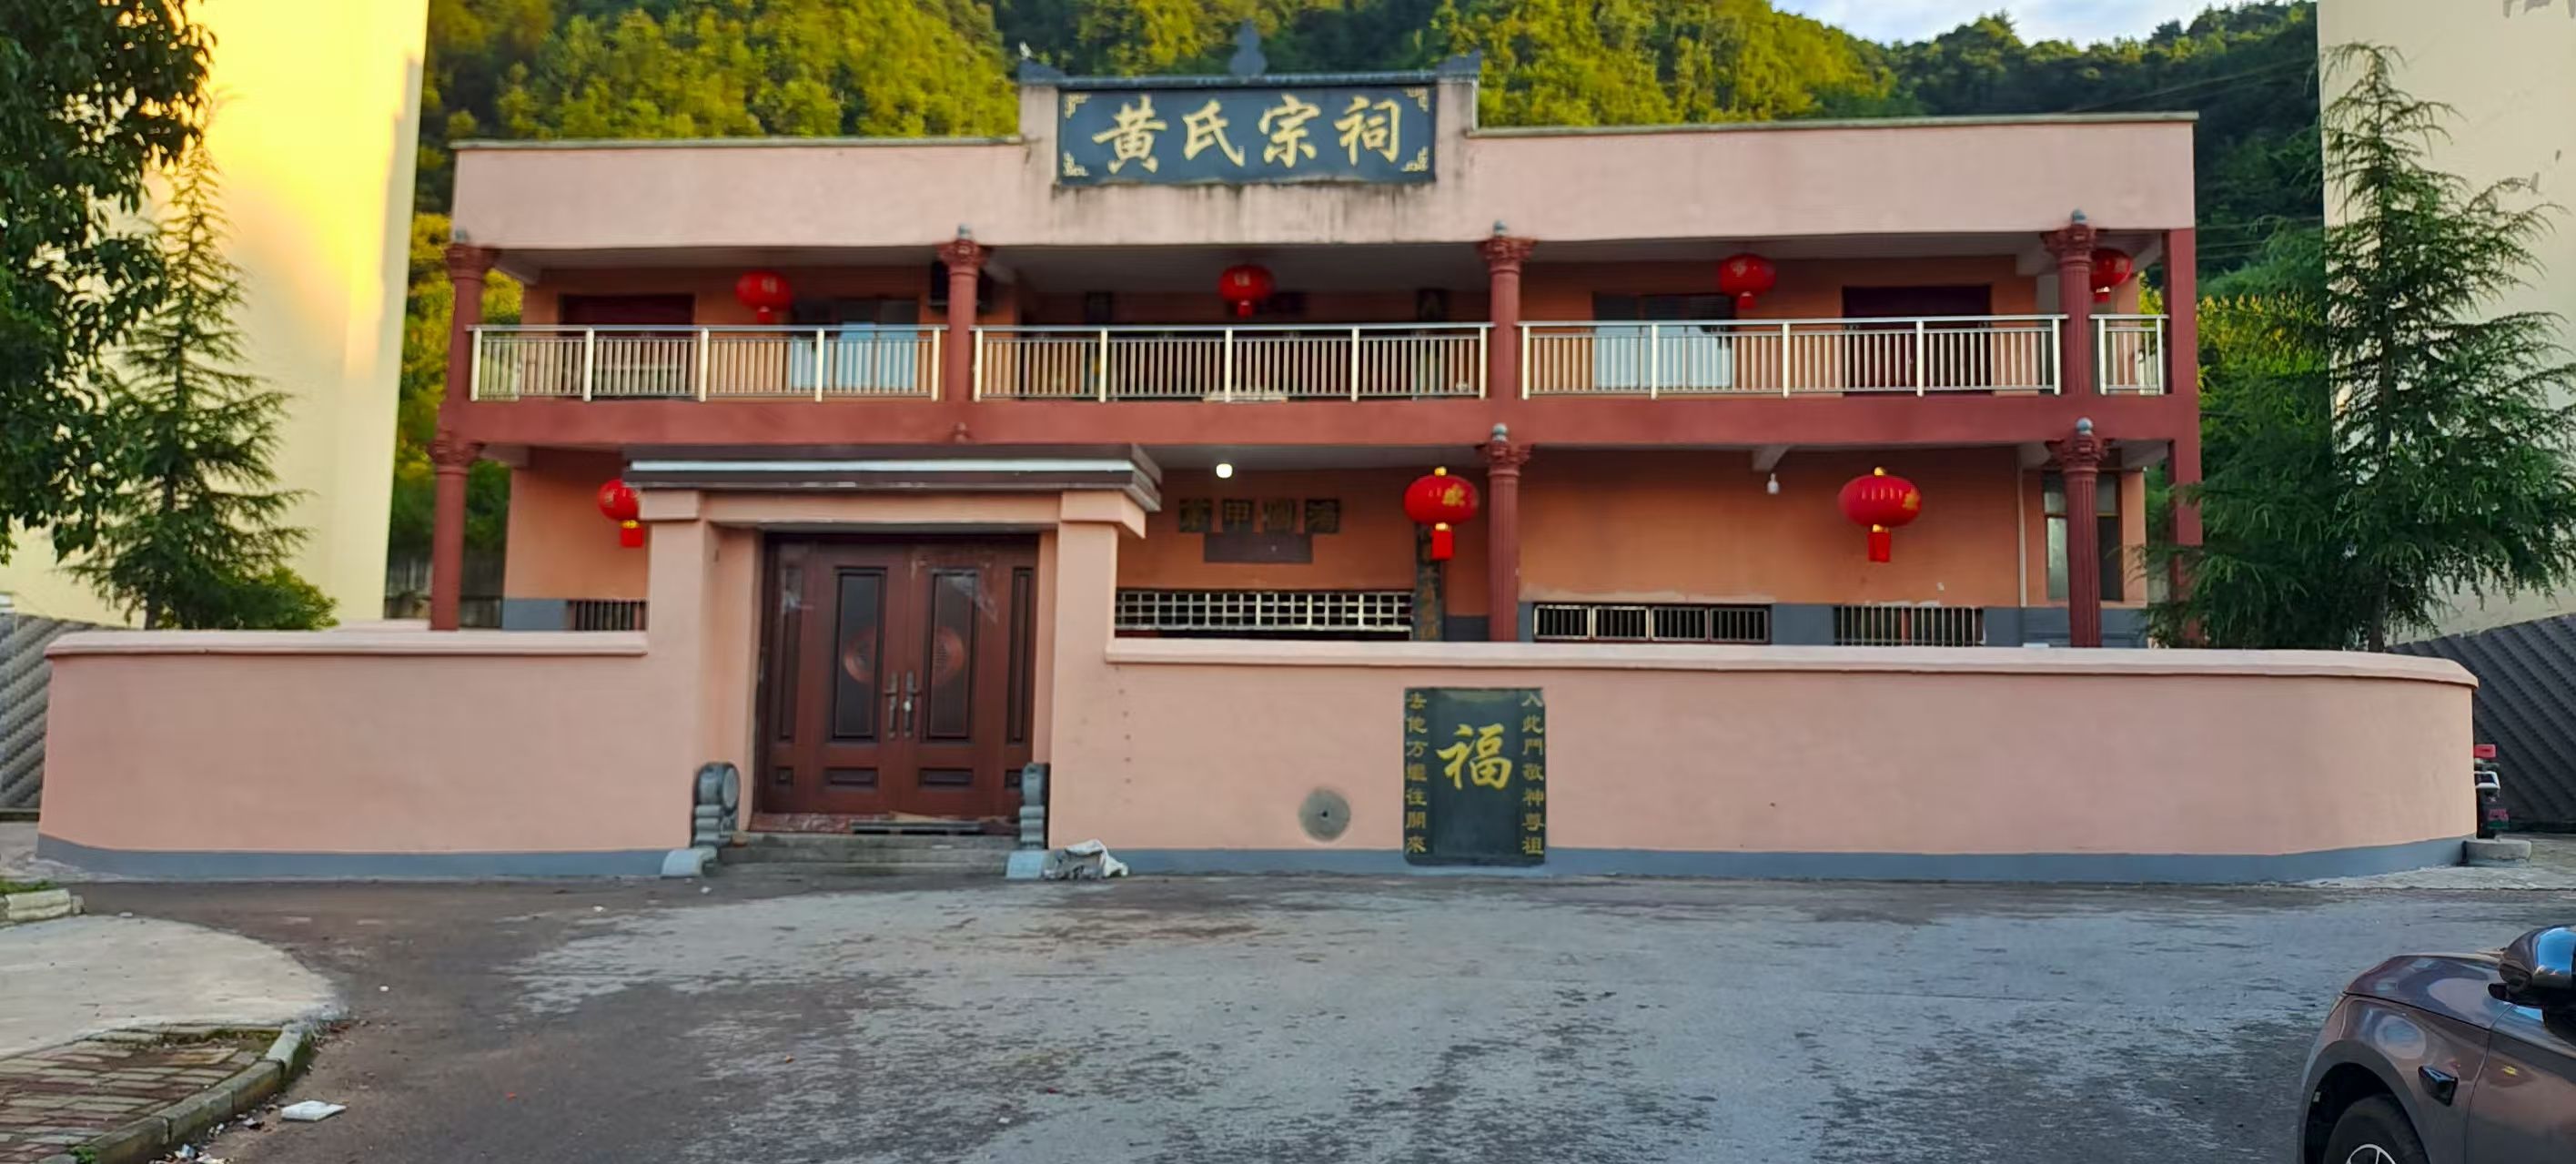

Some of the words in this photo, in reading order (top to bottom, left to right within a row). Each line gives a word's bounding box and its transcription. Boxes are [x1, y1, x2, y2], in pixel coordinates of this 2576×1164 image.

[1093, 94, 1401, 174] 黄氏宗祠
[1436, 723, 1512, 789] 福
